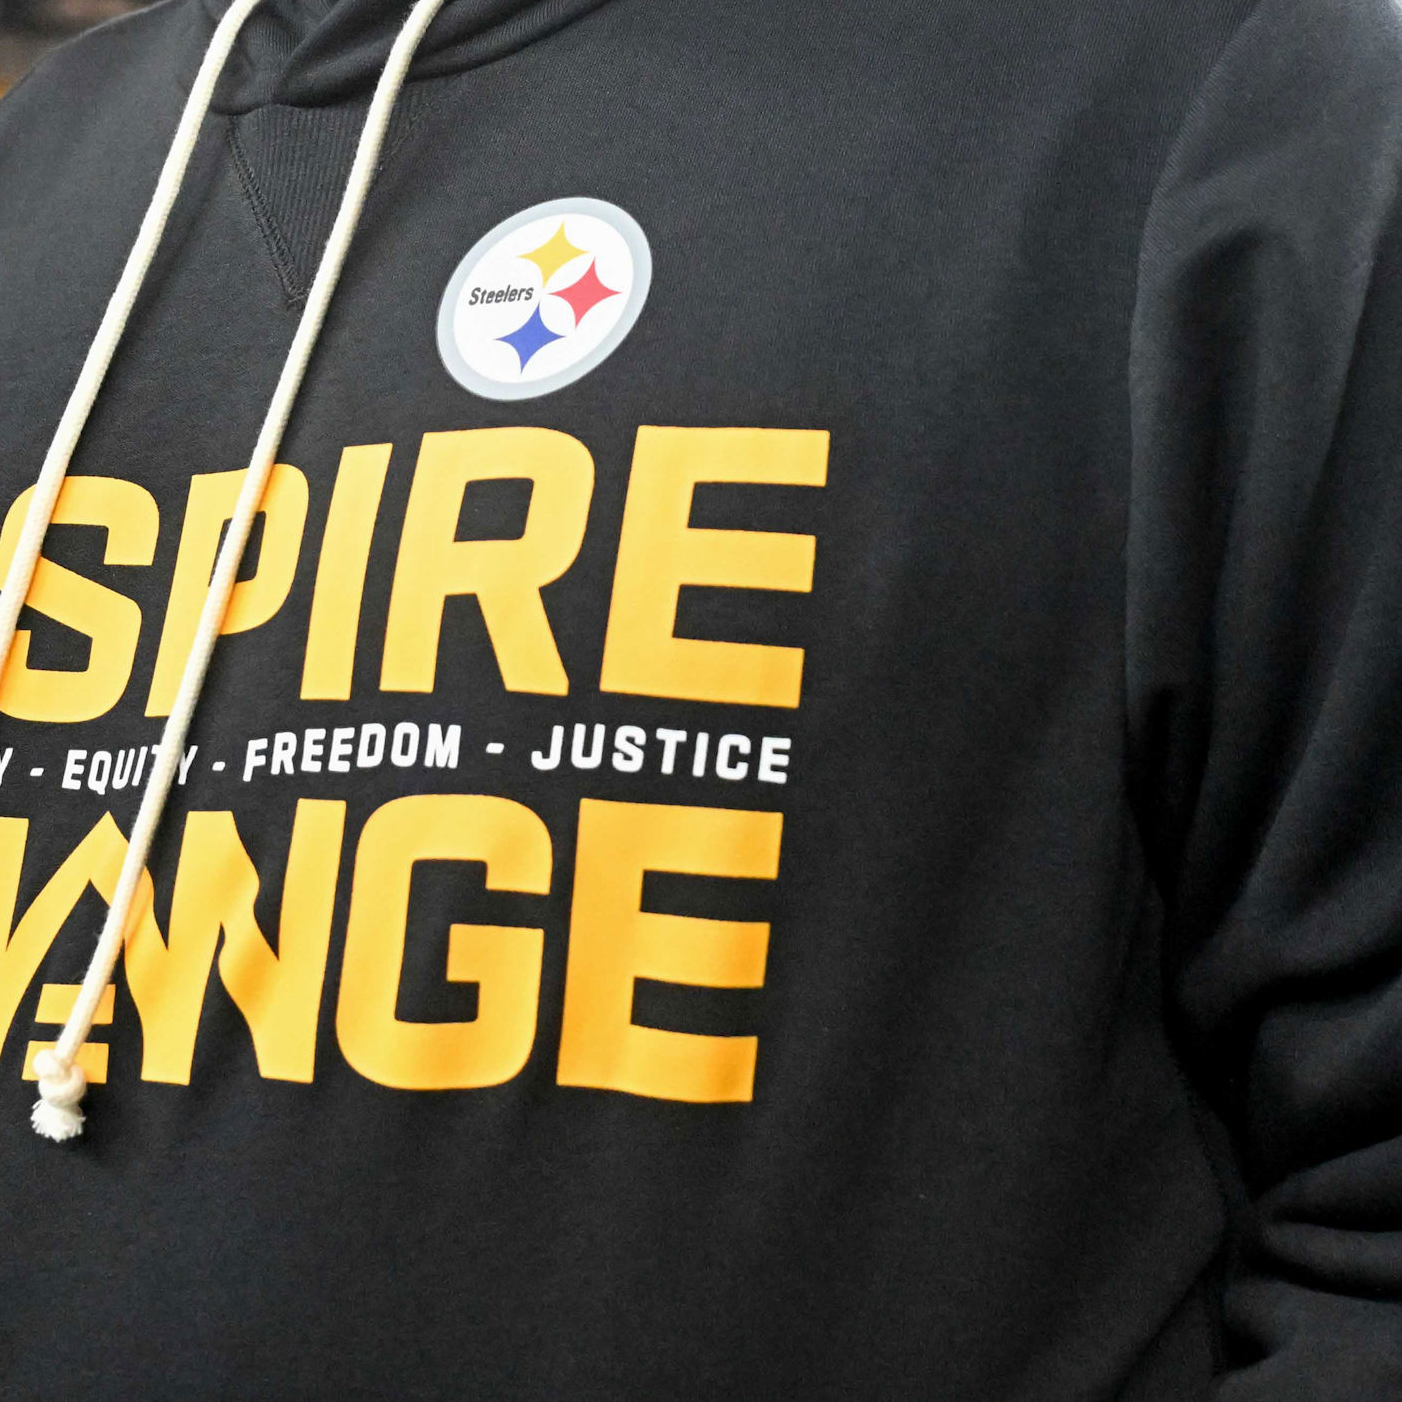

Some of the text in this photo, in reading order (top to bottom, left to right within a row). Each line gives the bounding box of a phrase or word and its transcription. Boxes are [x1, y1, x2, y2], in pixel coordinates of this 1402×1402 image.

[468, 284, 534, 306] Steelers
[243, 721, 461, 782] FREEDOM
[531, 723, 792, 784] JUSTICE
